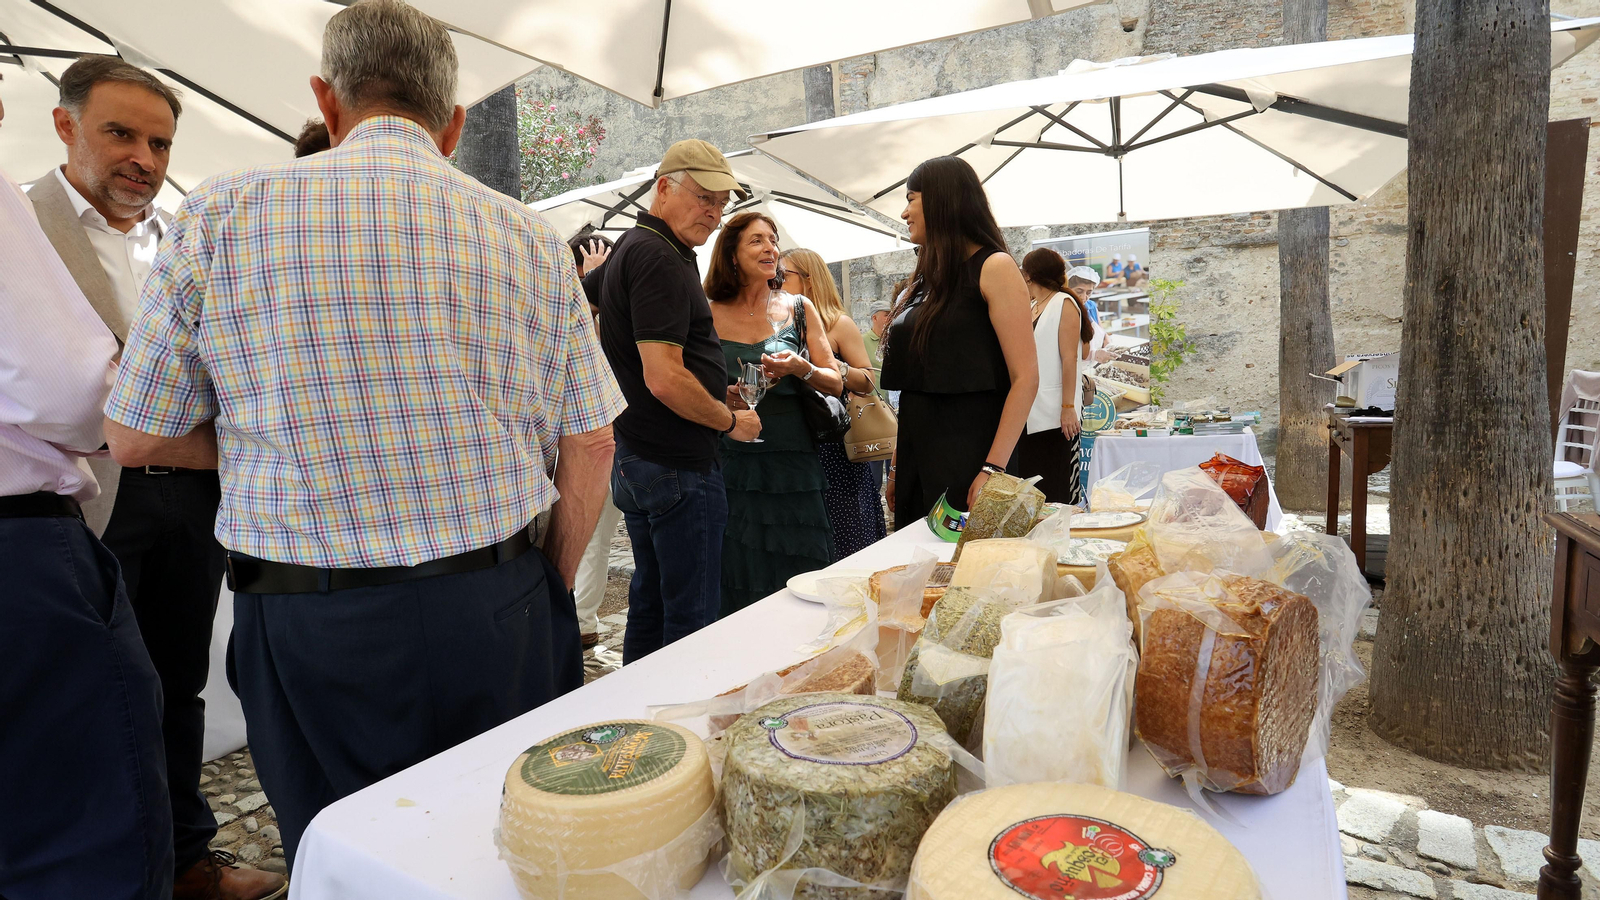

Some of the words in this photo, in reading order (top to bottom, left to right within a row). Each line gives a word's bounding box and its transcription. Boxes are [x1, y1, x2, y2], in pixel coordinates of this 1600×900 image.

[1062, 247, 1094, 257] badoras
[1096, 245, 1107, 253] De
[1109, 242, 1131, 252] Tarifa
[813, 709, 884, 731] Pastora
